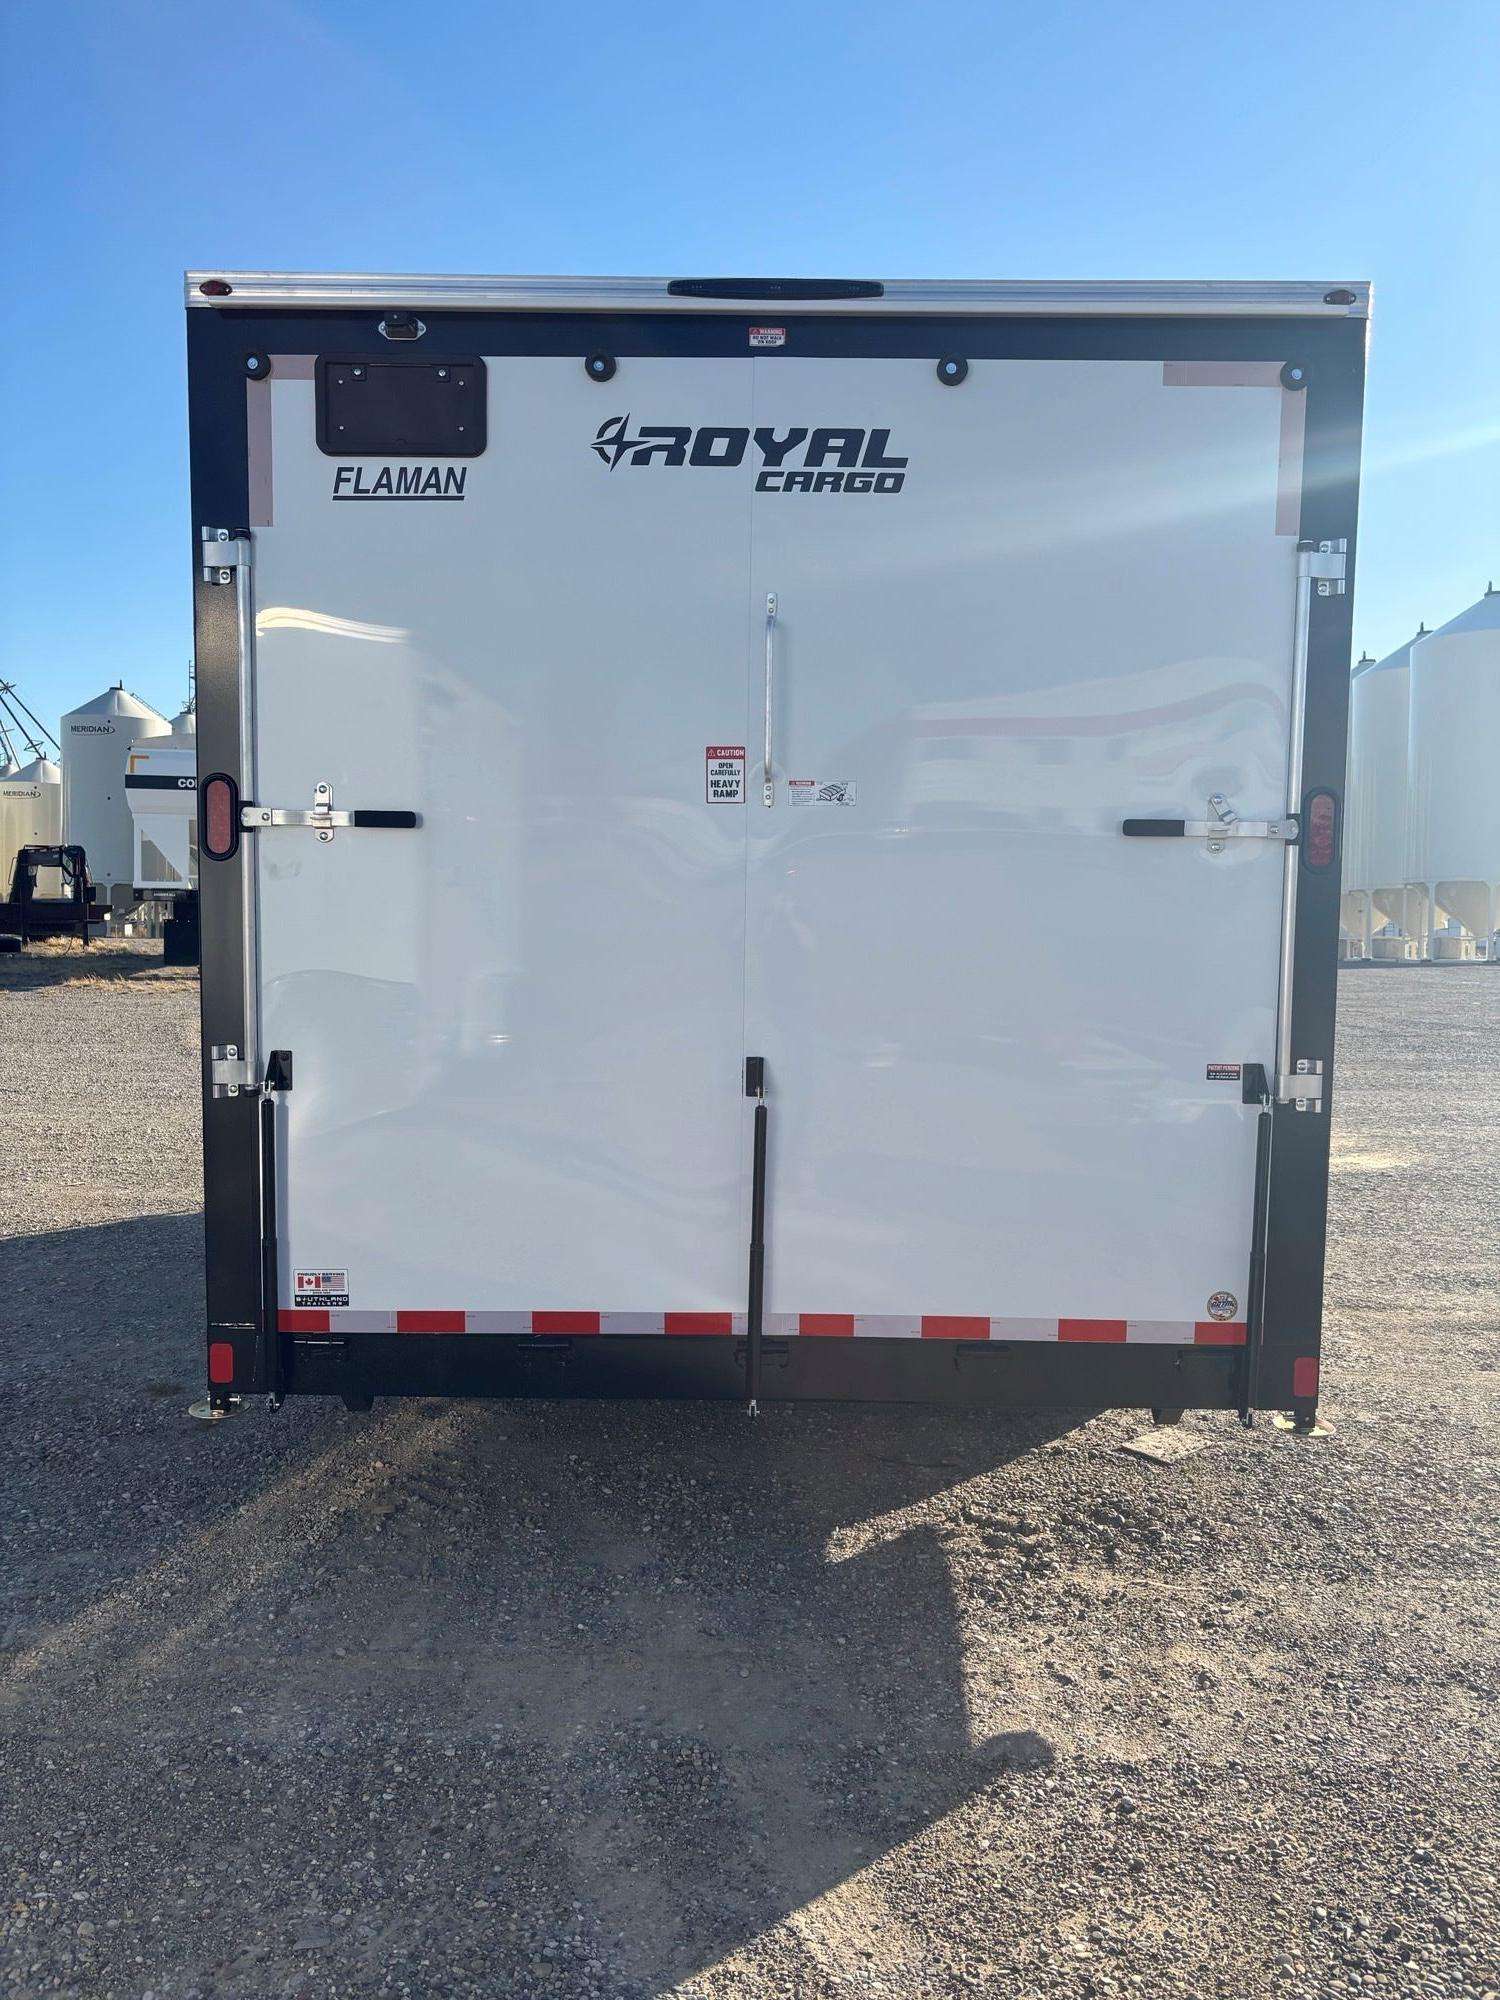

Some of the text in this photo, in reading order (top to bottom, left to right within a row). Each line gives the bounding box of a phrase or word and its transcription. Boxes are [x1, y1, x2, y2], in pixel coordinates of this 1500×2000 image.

[632, 427, 909, 467] ROYAL
[333, 466, 467, 495] FLAMAN
[755, 471, 906, 494] CARGO
[71, 725, 109, 733] MERIDIAN
[716, 749, 745, 757] CAUTION
[178, 778, 197, 788] CO
[710, 780, 741, 788] HEAVY
[713, 790, 739, 798] RAMP
